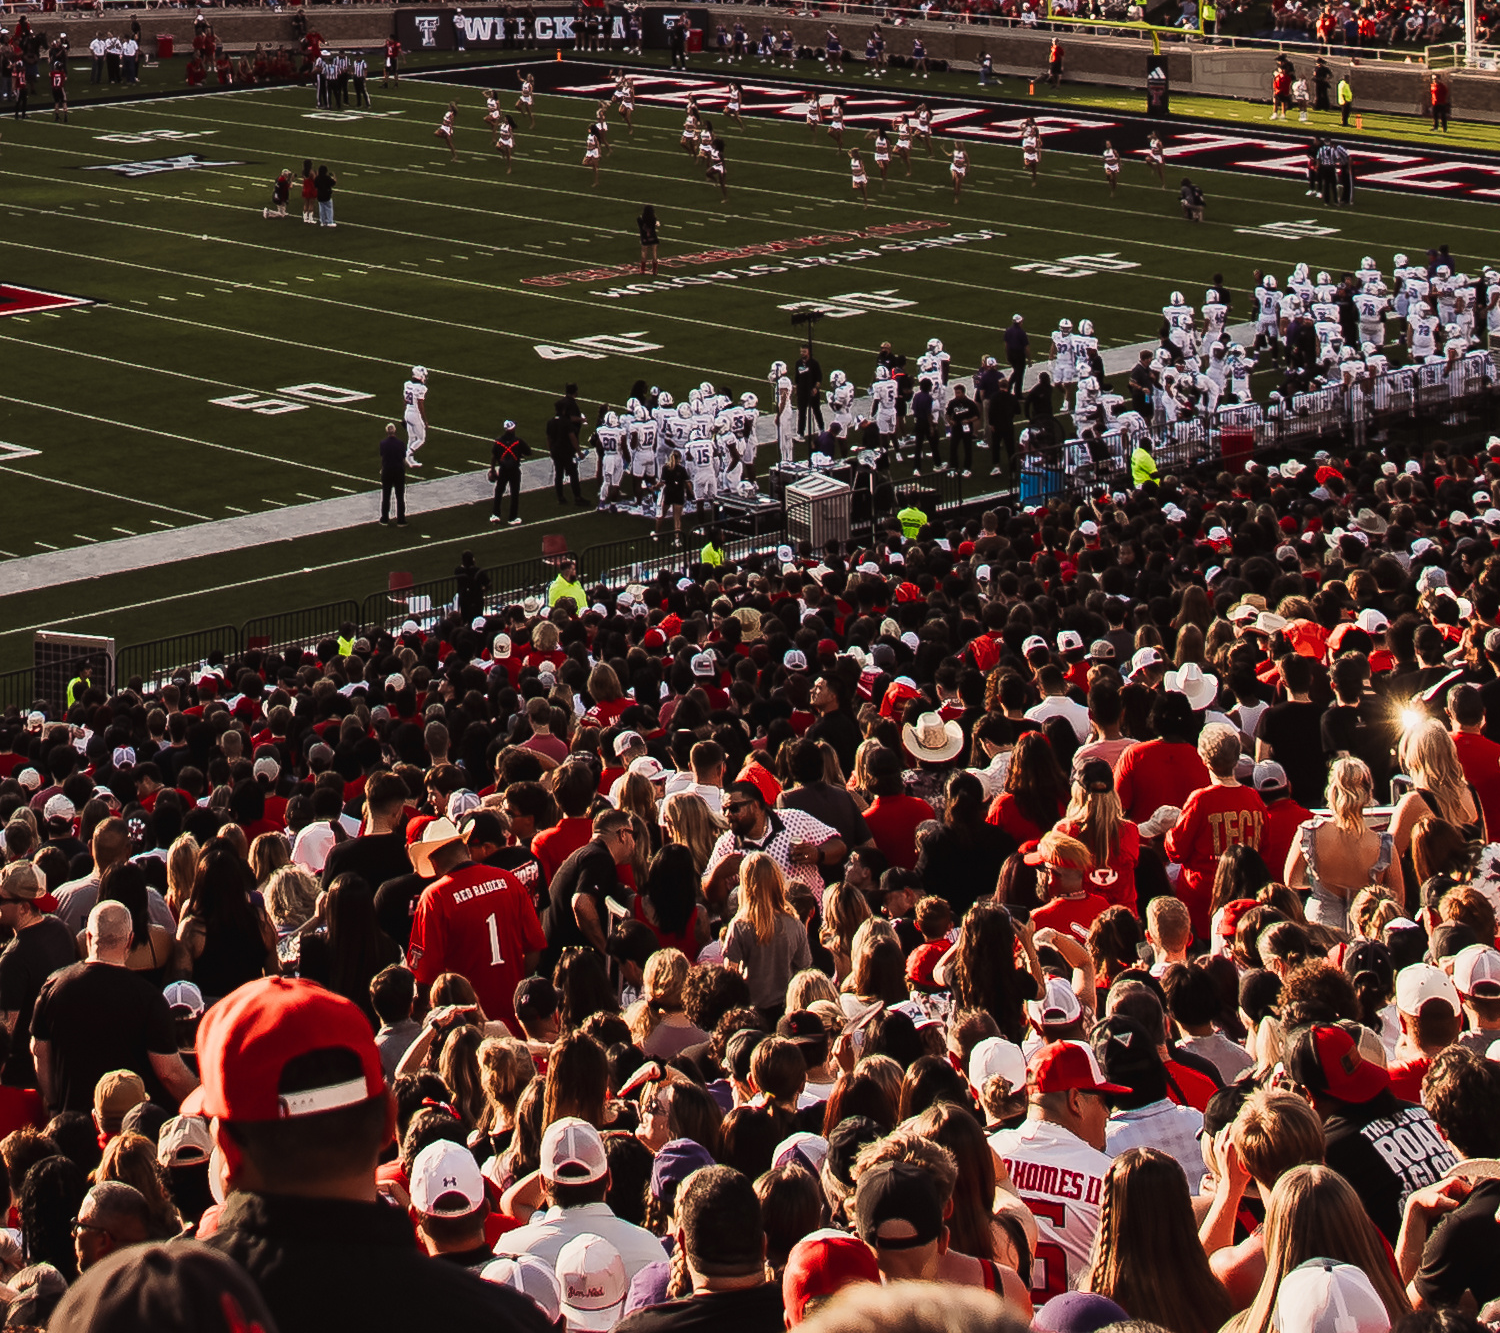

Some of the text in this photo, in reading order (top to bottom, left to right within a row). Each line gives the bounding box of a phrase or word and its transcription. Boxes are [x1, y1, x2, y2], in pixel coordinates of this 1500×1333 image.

[208, 382, 376, 416] 50
[453, 878, 508, 906] RED RAIDERS
[486, 912, 505, 967] 1
[1360, 1117, 1397, 1141] THIS
